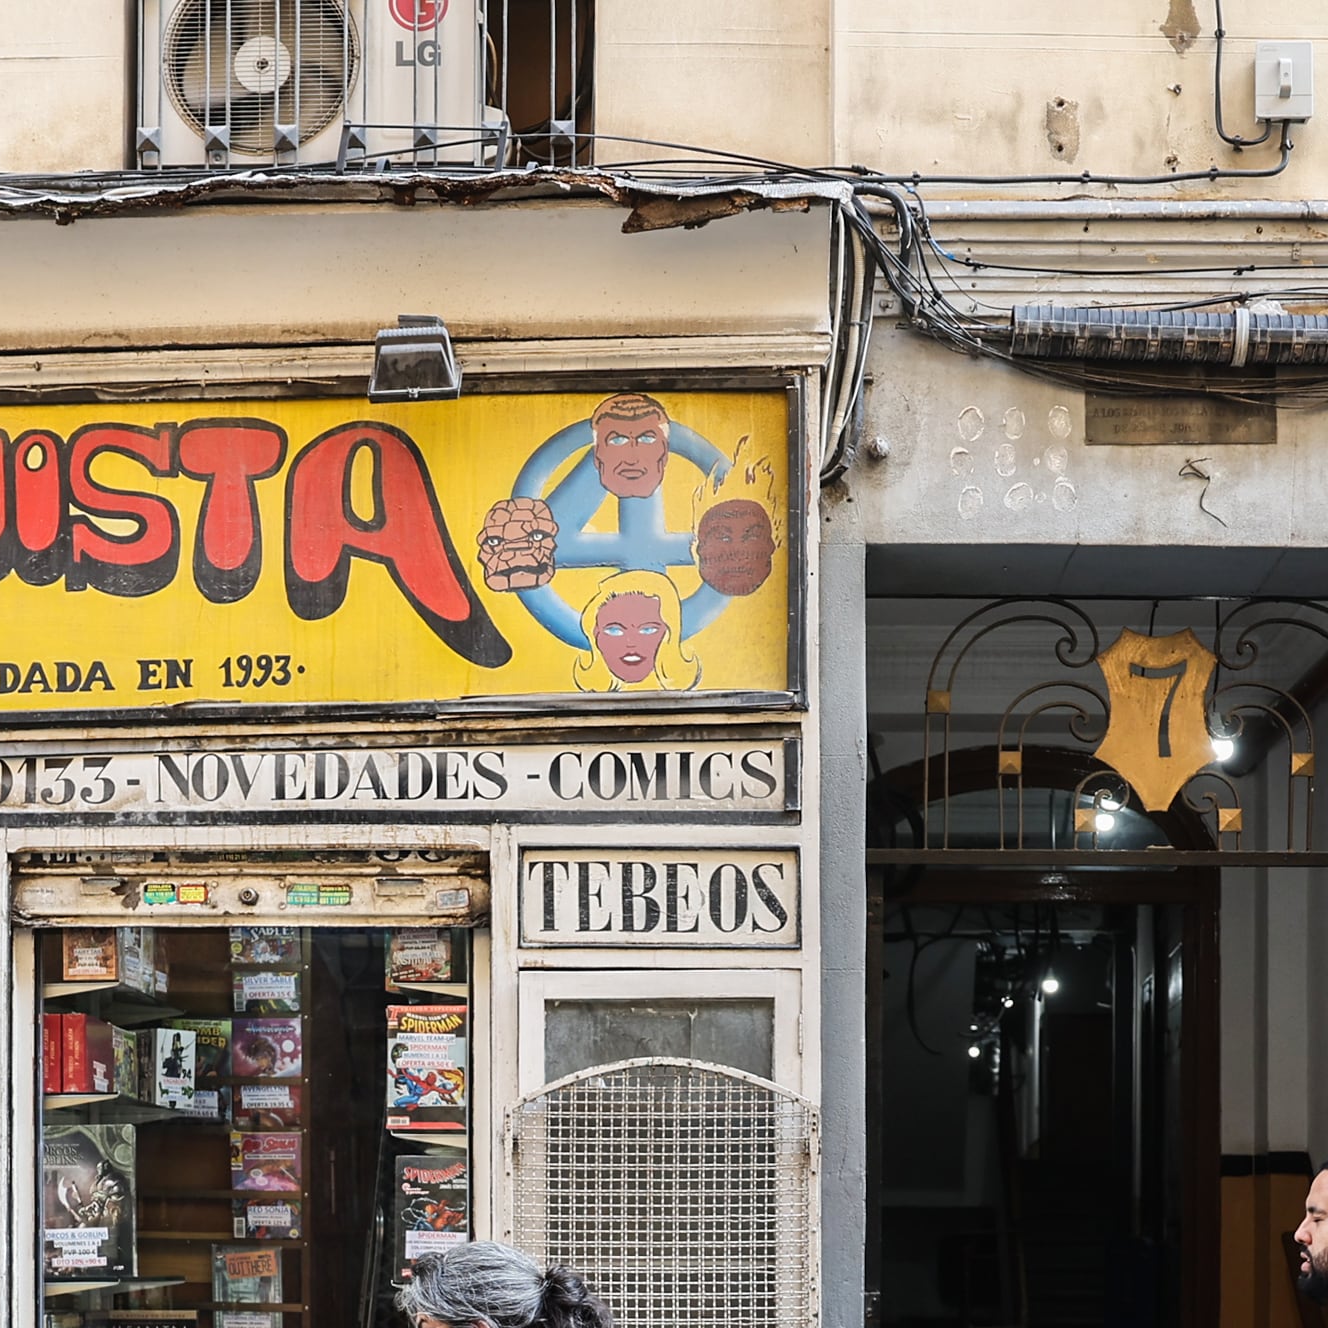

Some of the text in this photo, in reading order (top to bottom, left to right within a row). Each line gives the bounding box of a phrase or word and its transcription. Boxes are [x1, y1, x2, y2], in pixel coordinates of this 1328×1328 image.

[395, 40, 442, 67] LG
[137, 659, 193, 690] EN
[219, 655, 293, 689] 1993
[1130, 658, 1190, 758] 7
[154, 751, 509, 803] NOVEDADES
[549, 749, 778, 801] COMICS
[528, 861, 788, 934] TEBEOS
[400, 1014, 464, 1034] SPIDERMAN
[197, 1037, 228, 1049] IDER
[78, 1231, 107, 1239] GOBLINS
